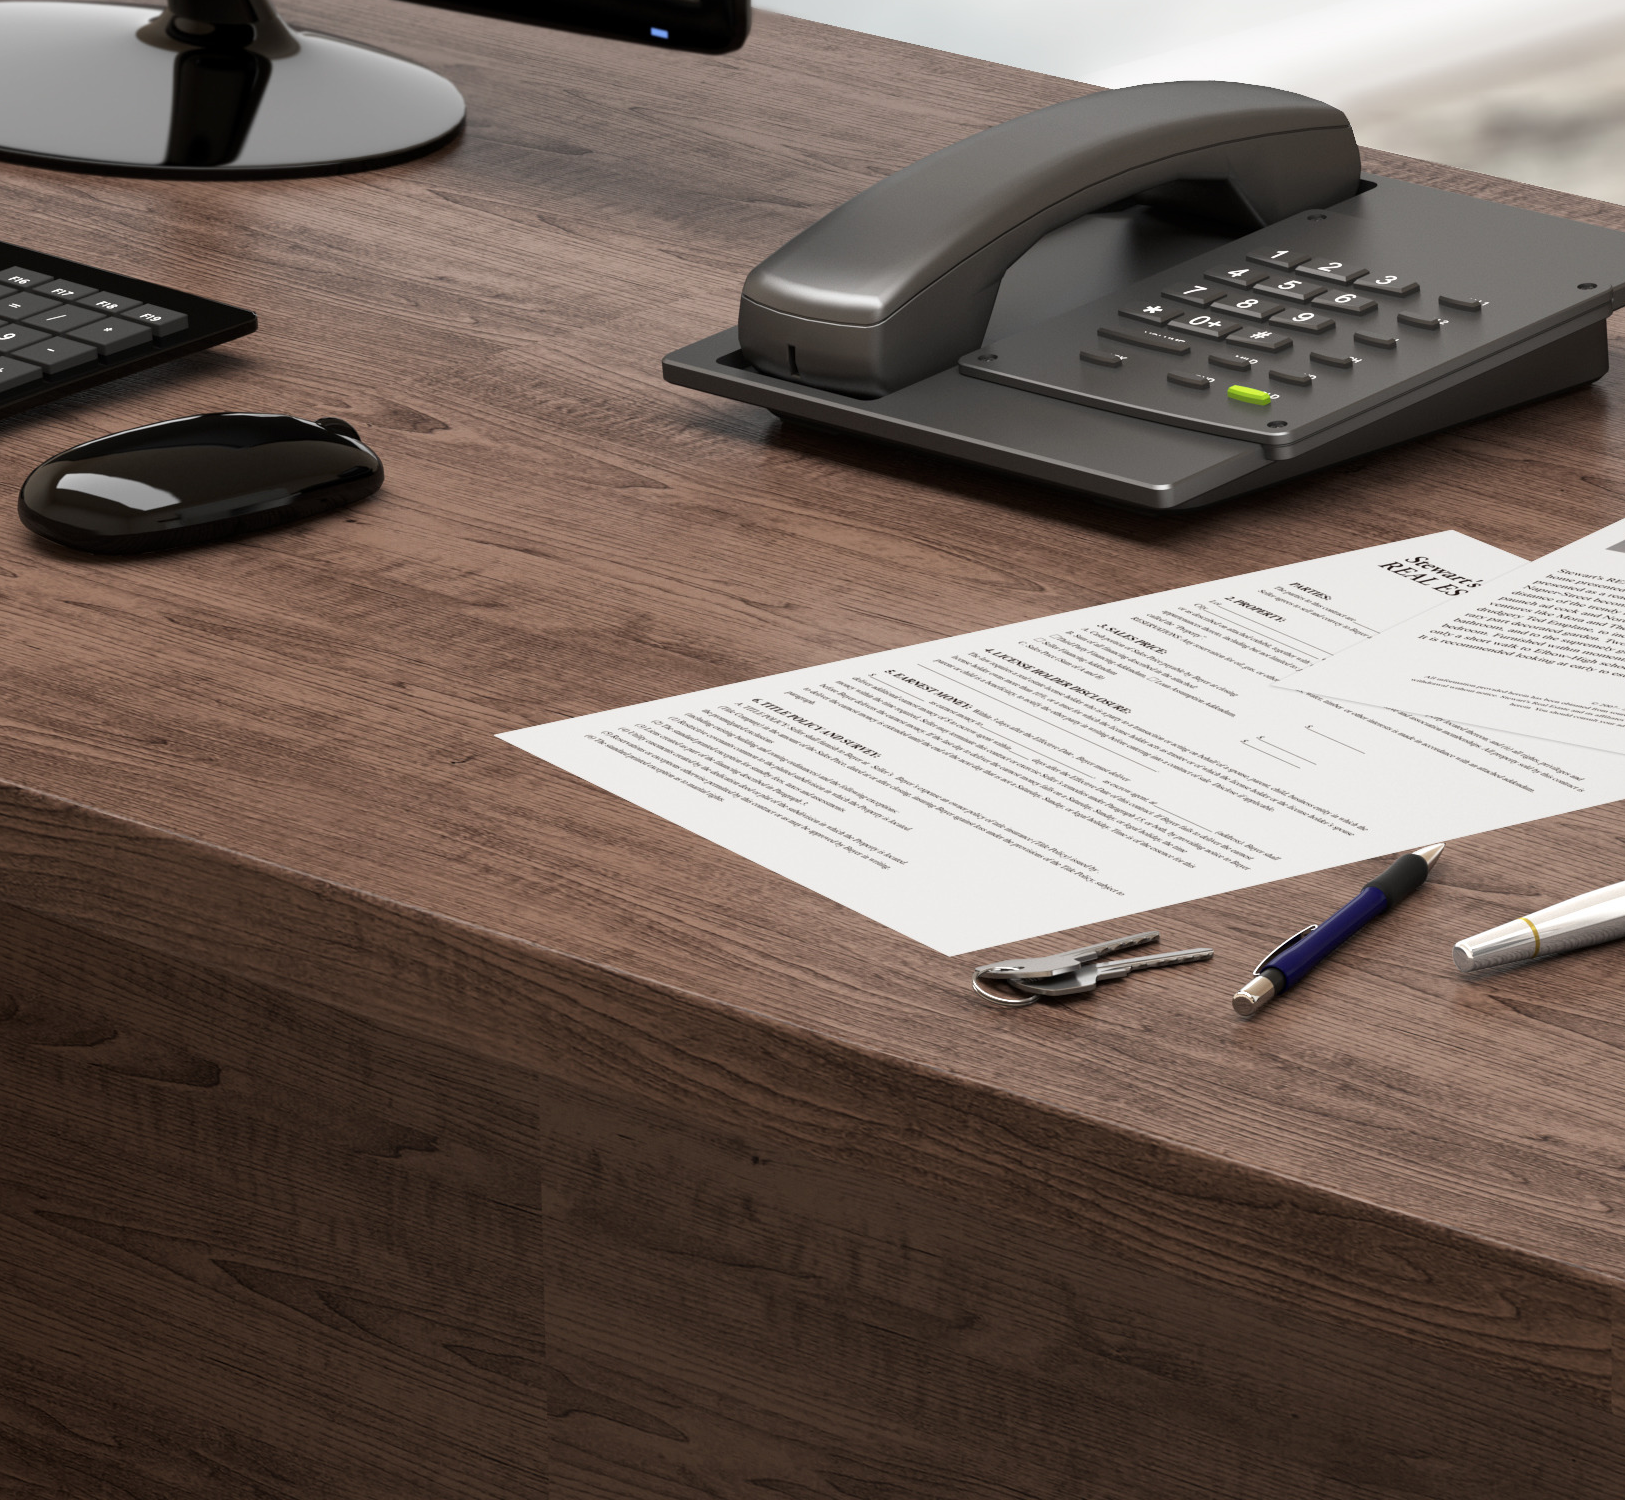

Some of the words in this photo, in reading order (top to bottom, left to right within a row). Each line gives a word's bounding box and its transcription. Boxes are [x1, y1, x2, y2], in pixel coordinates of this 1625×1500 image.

[1270, 250, 1289, 260] 1
[1227, 268, 1250, 278] 4
[1318, 262, 1343, 273] 2
[1277, 280, 1303, 291] 5
[1375, 275, 1398, 286] 3
[1183, 286, 1208, 297] 7
[1334, 293, 1357, 304] 6
[1236, 299, 1260, 310] 8
[1292, 312, 1315, 323] 9
[1378, 561, 1439, 586] REAL
[1405, 556, 1484, 588] Stewart's
